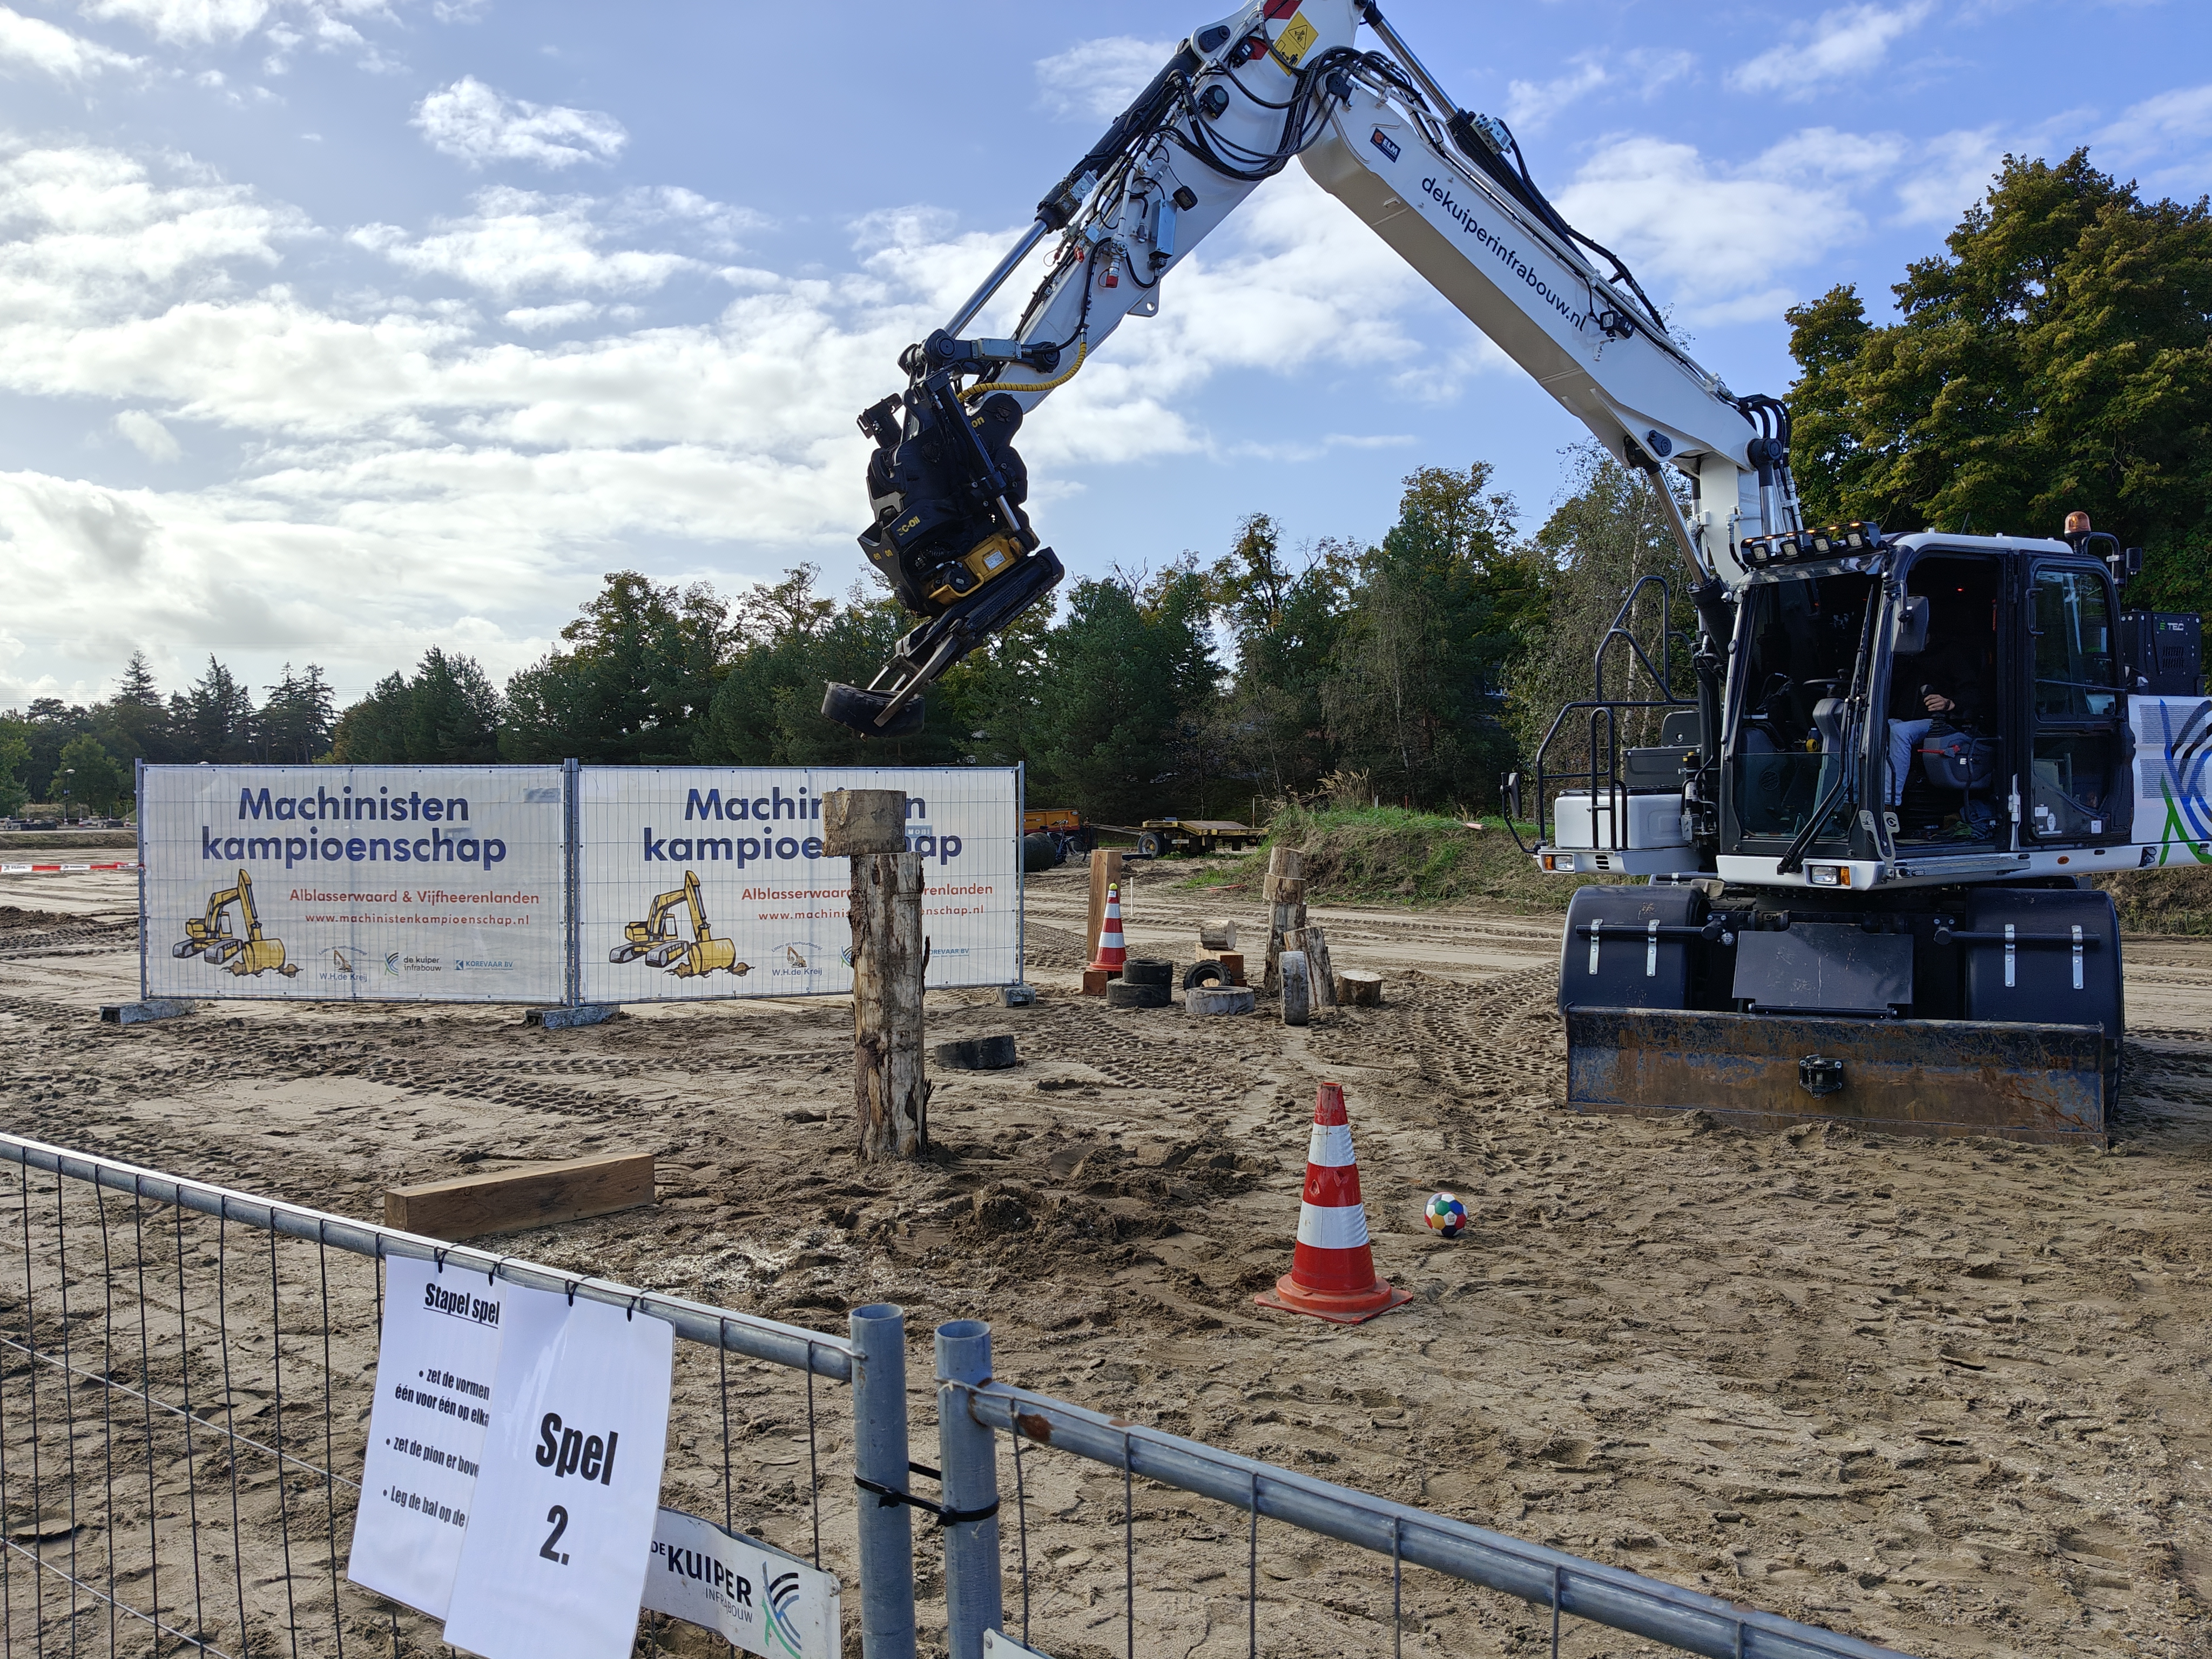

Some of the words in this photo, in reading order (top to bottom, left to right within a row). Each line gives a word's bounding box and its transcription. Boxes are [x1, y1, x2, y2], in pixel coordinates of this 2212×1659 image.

[1421, 177, 1587, 332] dekuiperinfrabouw.nl
[239, 786, 468, 821] Machinisten
[685, 786, 926, 821] Machin
[202, 826, 507, 870] kampioenschap
[289, 889, 397, 902] Alblasserwaard
[402, 892, 413, 902] &
[417, 890, 539, 906] Vijfheerenlanden
[305, 913, 529, 927] www.machinistenkampioenschap.nl
[350, 973, 367, 982] Kreij
[416, 956, 440, 965] kuiper
[804, 967, 822, 975] Kreij
[424, 1282, 470, 1316] Stapel
[472, 1299, 500, 1324] spel
[426, 1368, 441, 1385] zet
[442, 1371, 454, 1389] de
[456, 1377, 490, 1400] vormen
[395, 1384, 414, 1402] één
[416, 1392, 437, 1410] voor
[439, 1395, 456, 1416] één
[458, 1403, 469, 1421] op
[393, 1437, 408, 1453] zet
[409, 1439, 422, 1457] de
[423, 1445, 444, 1465] pion
[446, 1454, 457, 1470] er
[535, 1412, 618, 1486] Spel
[390, 1485, 407, 1507] Leg
[409, 1492, 421, 1511] de
[422, 1496, 437, 1518] bal
[439, 1505, 451, 1524] op
[452, 1509, 466, 1528] de
[539, 1505, 569, 1565] 2.
[651, 1541, 666, 1556] DE
[668, 1545, 753, 1608] KUIPER
[706, 1587, 753, 1623] INFRABOUW
